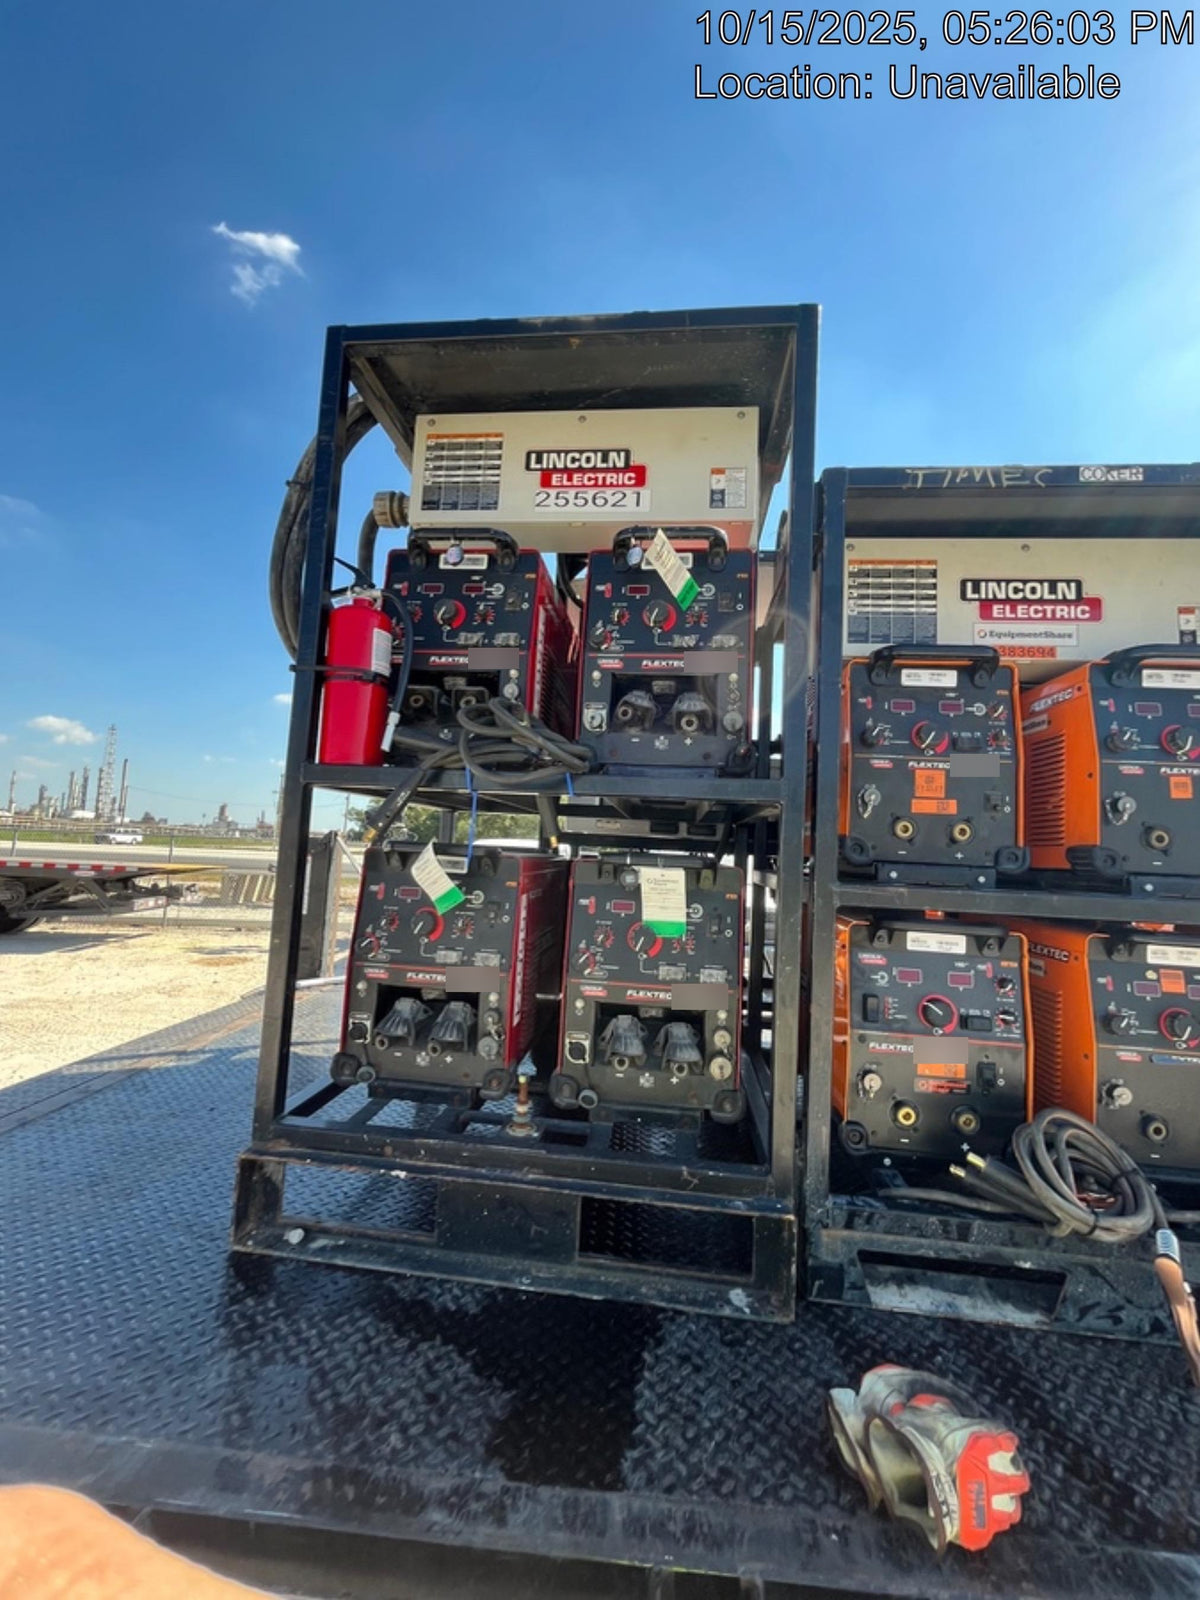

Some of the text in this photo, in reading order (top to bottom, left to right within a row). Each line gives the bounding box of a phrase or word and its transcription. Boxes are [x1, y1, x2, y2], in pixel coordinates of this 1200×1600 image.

[530, 451, 627, 469] LINCOLN
[551, 473, 637, 487] ELECTRIC
[535, 490, 642, 508] 255621
[966, 581, 1078, 600] LINCOLN
[992, 604, 1091, 620] ELECTRIC
